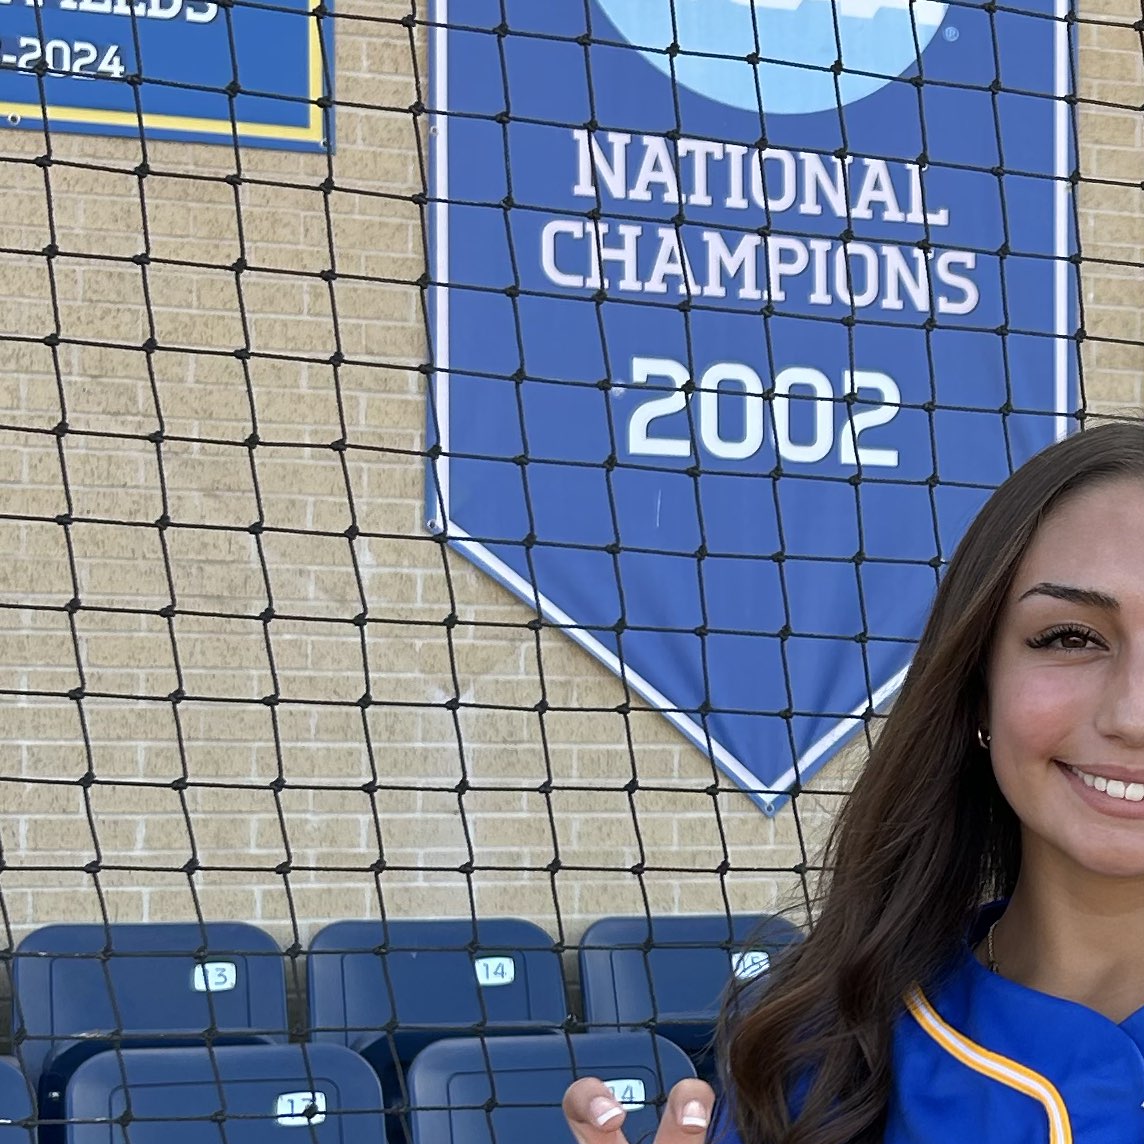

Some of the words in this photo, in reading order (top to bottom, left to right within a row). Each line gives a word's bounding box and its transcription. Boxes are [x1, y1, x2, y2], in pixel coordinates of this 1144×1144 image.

[573, 128, 950, 226] NATIONAL
[541, 219, 979, 315] CHAMPIONS
[628, 357, 900, 467] 2002
[483, 962, 507, 980] 14
